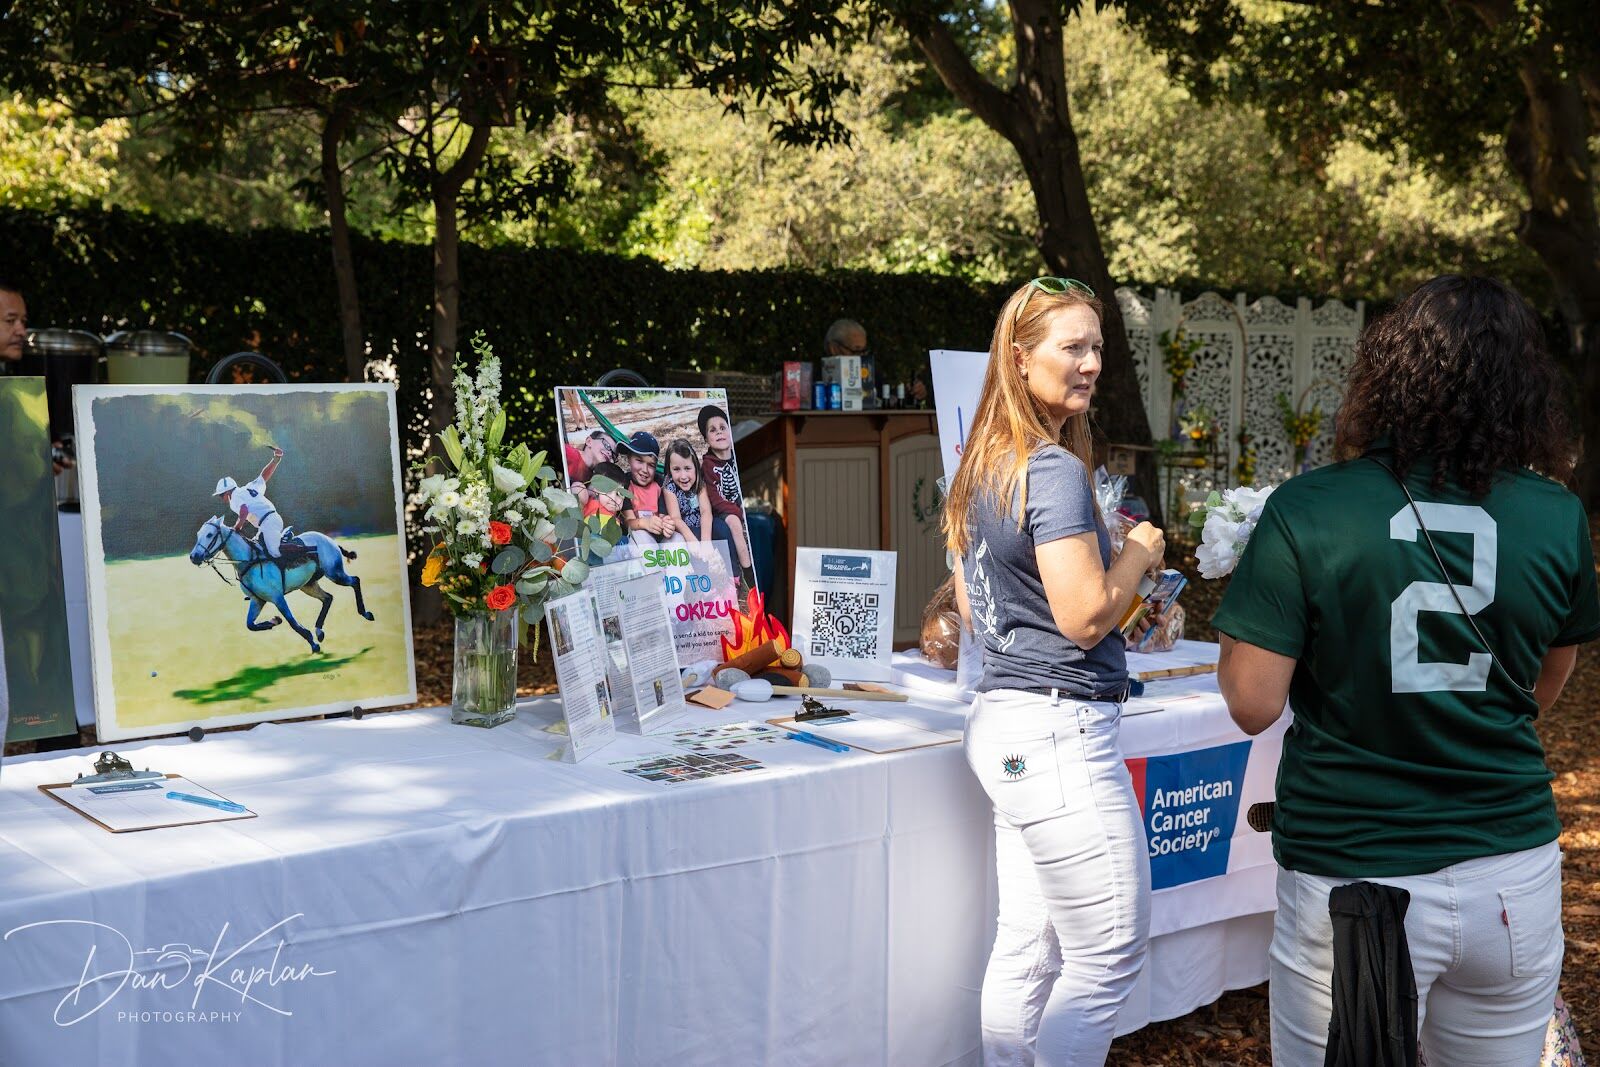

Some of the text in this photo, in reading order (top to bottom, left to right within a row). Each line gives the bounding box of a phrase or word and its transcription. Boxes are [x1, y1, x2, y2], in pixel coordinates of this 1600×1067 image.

[643, 549, 690, 567] SEND
[663, 574, 712, 595] ID TO
[1389, 500, 1497, 694] 2
[679, 631, 692, 639] send
[1151, 779, 1233, 810] American
[1151, 806, 1211, 833] Cancer
